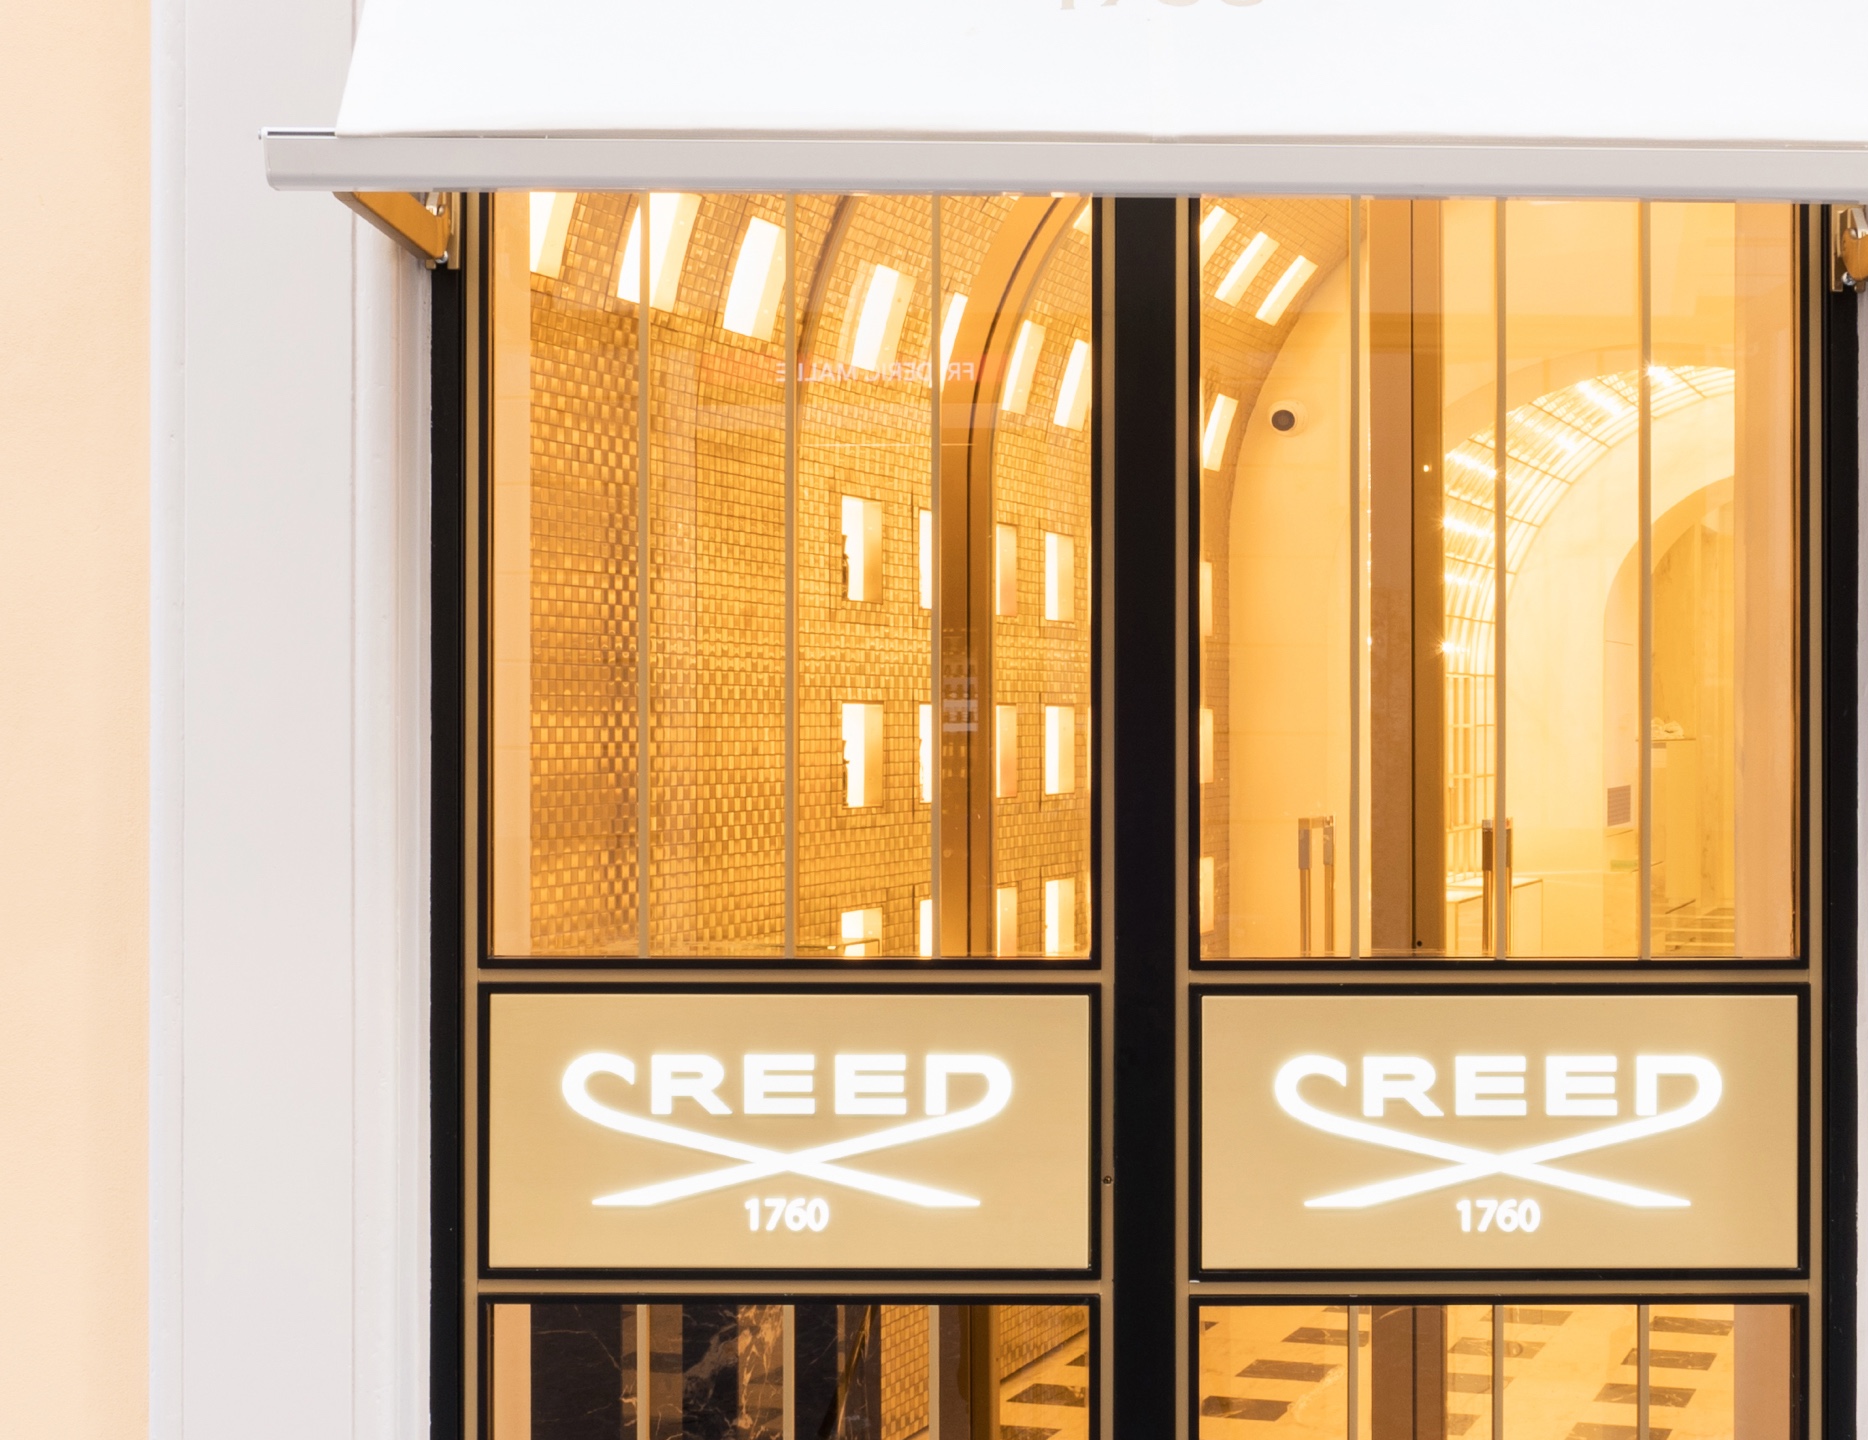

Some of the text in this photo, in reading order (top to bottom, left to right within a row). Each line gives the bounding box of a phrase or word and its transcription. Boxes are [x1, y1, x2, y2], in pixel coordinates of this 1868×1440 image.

[561, 1051, 1013, 1135] CREED
[1274, 1053, 1723, 1137] CREED
[743, 1197, 830, 1233] 1760
[1455, 1198, 1541, 1233] 1760
